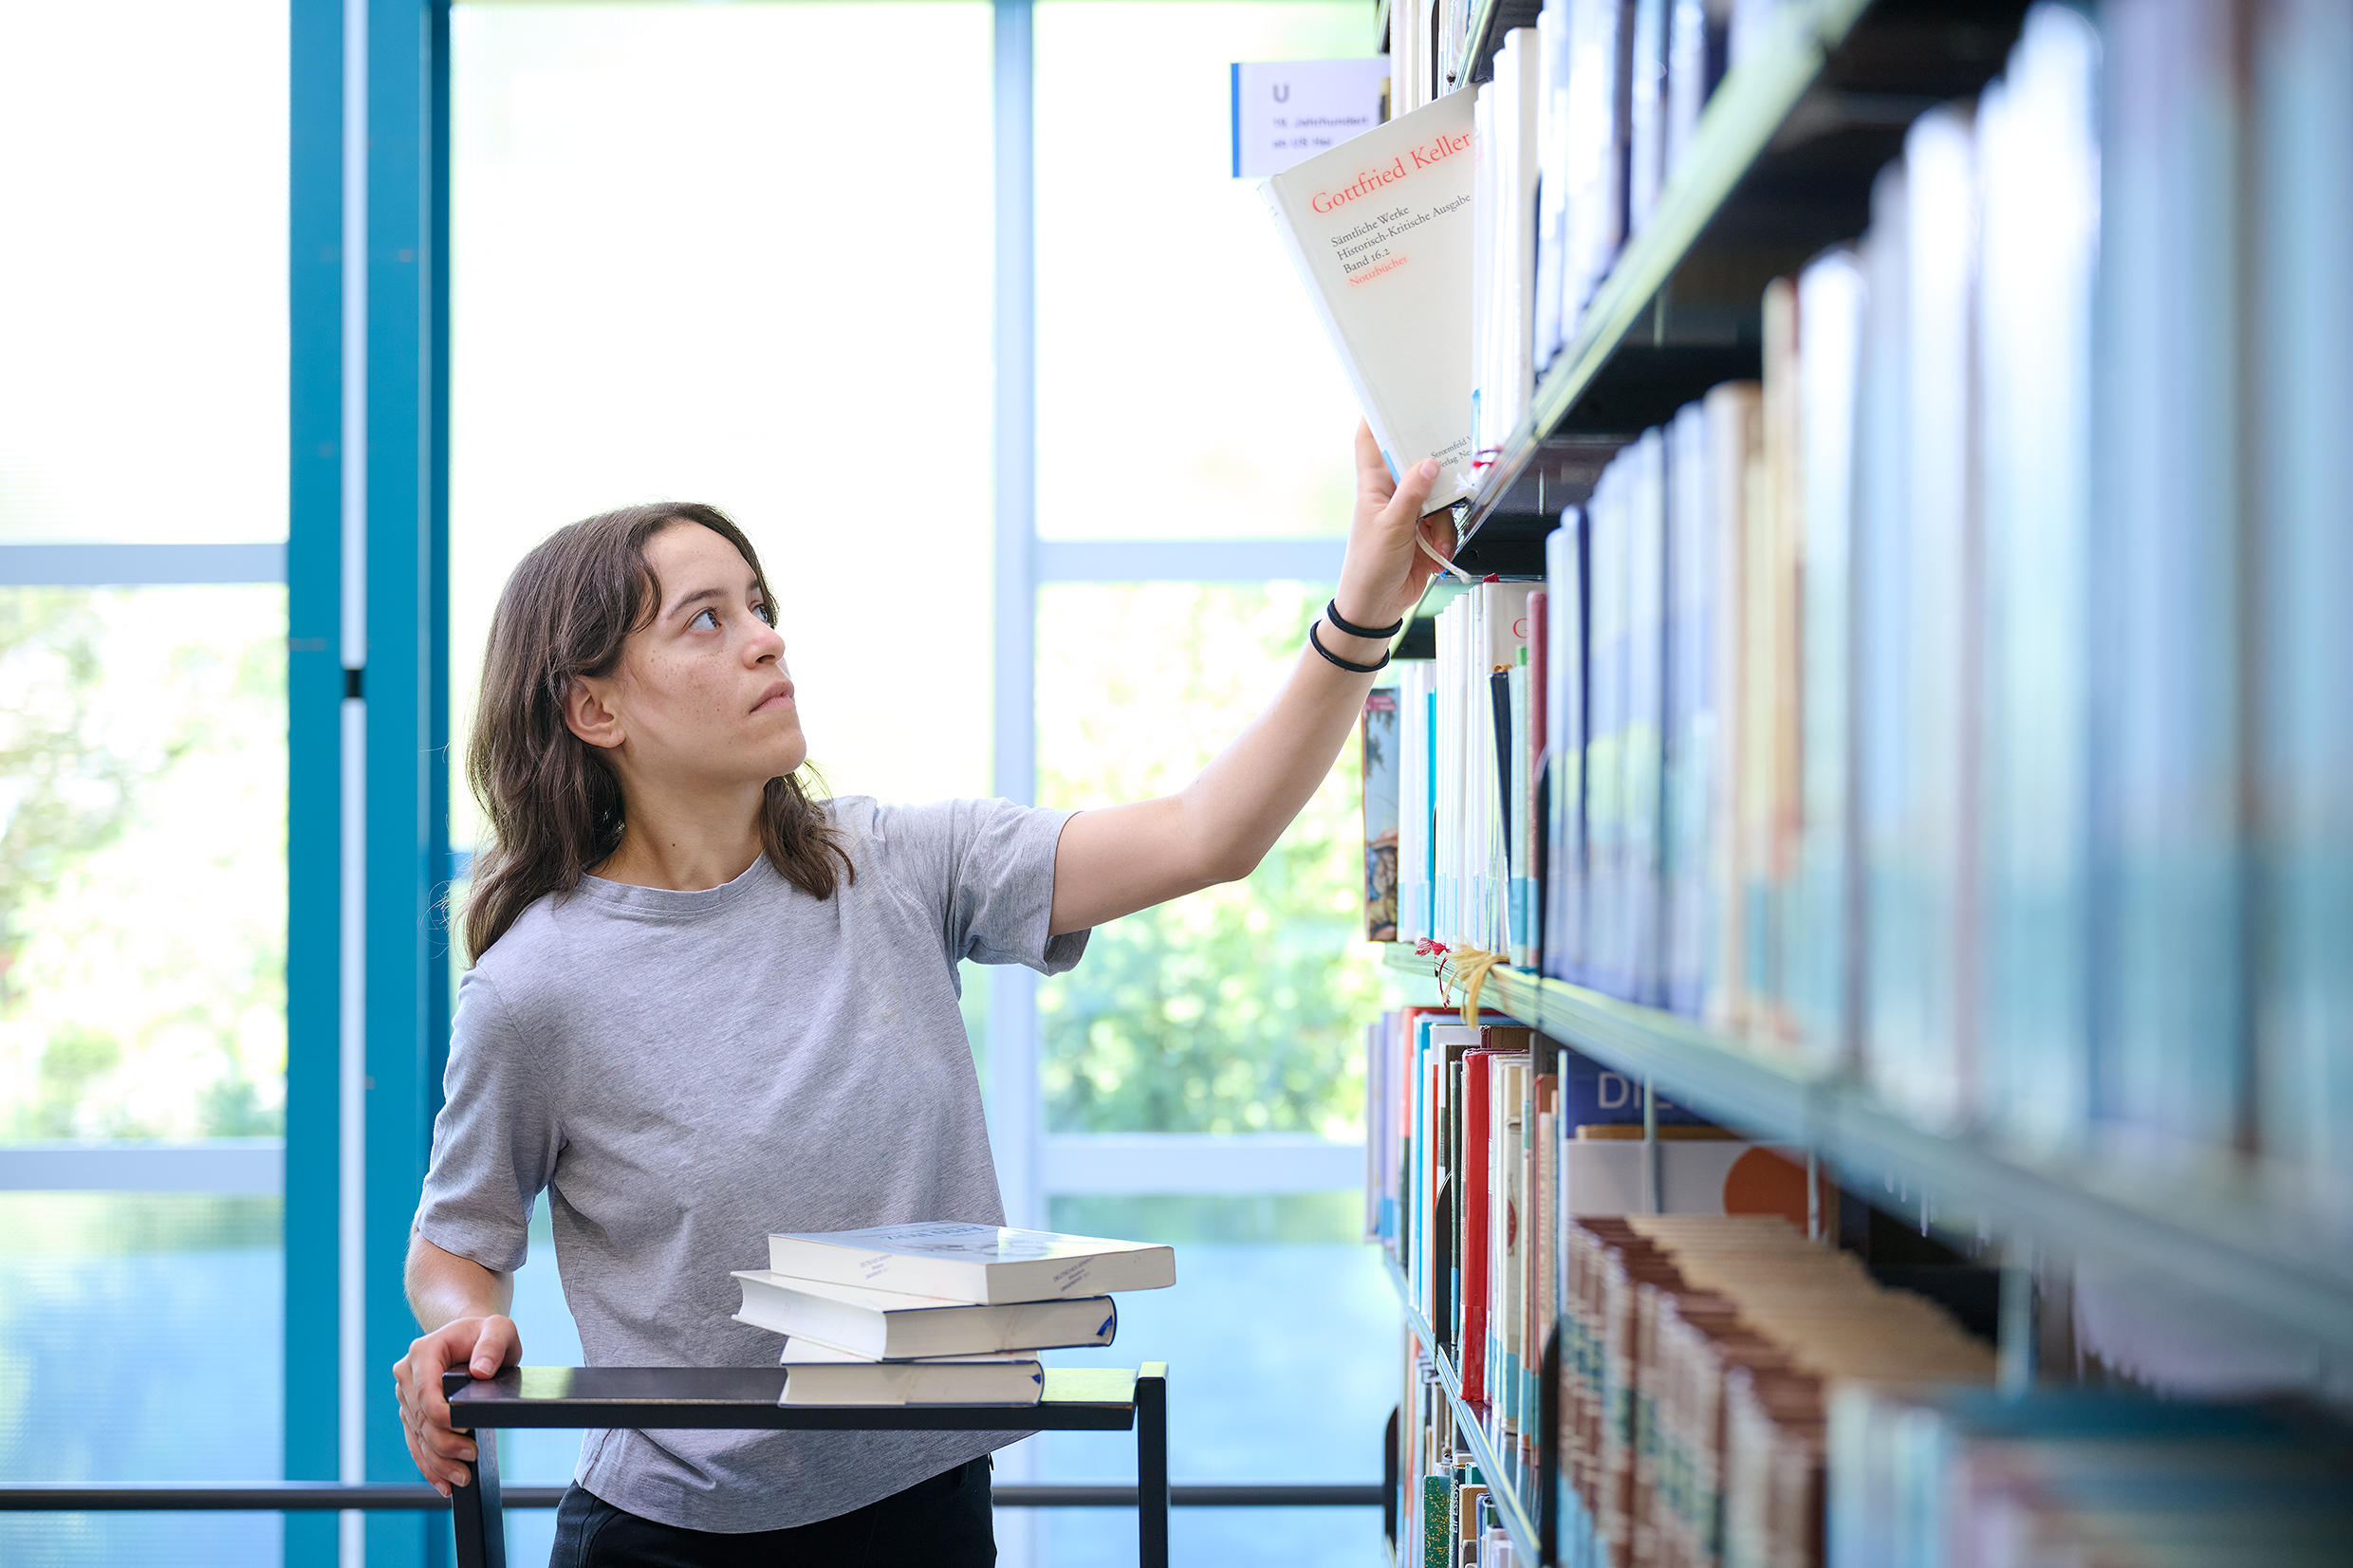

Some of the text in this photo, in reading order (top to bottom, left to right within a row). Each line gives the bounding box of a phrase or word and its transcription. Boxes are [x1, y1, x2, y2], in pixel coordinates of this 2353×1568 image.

[1273, 84, 1289, 103] U
[1312, 157, 1406, 213] Gottfried
[1410, 133, 1470, 170] Keller
[1330, 206, 1410, 248] Sämtliche Werke
[1337, 194, 1472, 261] Historisch-Kritische Ausgabe
[1343, 249, 1391, 274] Band 16.2
[1349, 255, 1408, 286] Notizbücher
[1439, 455, 1458, 468] erlag
